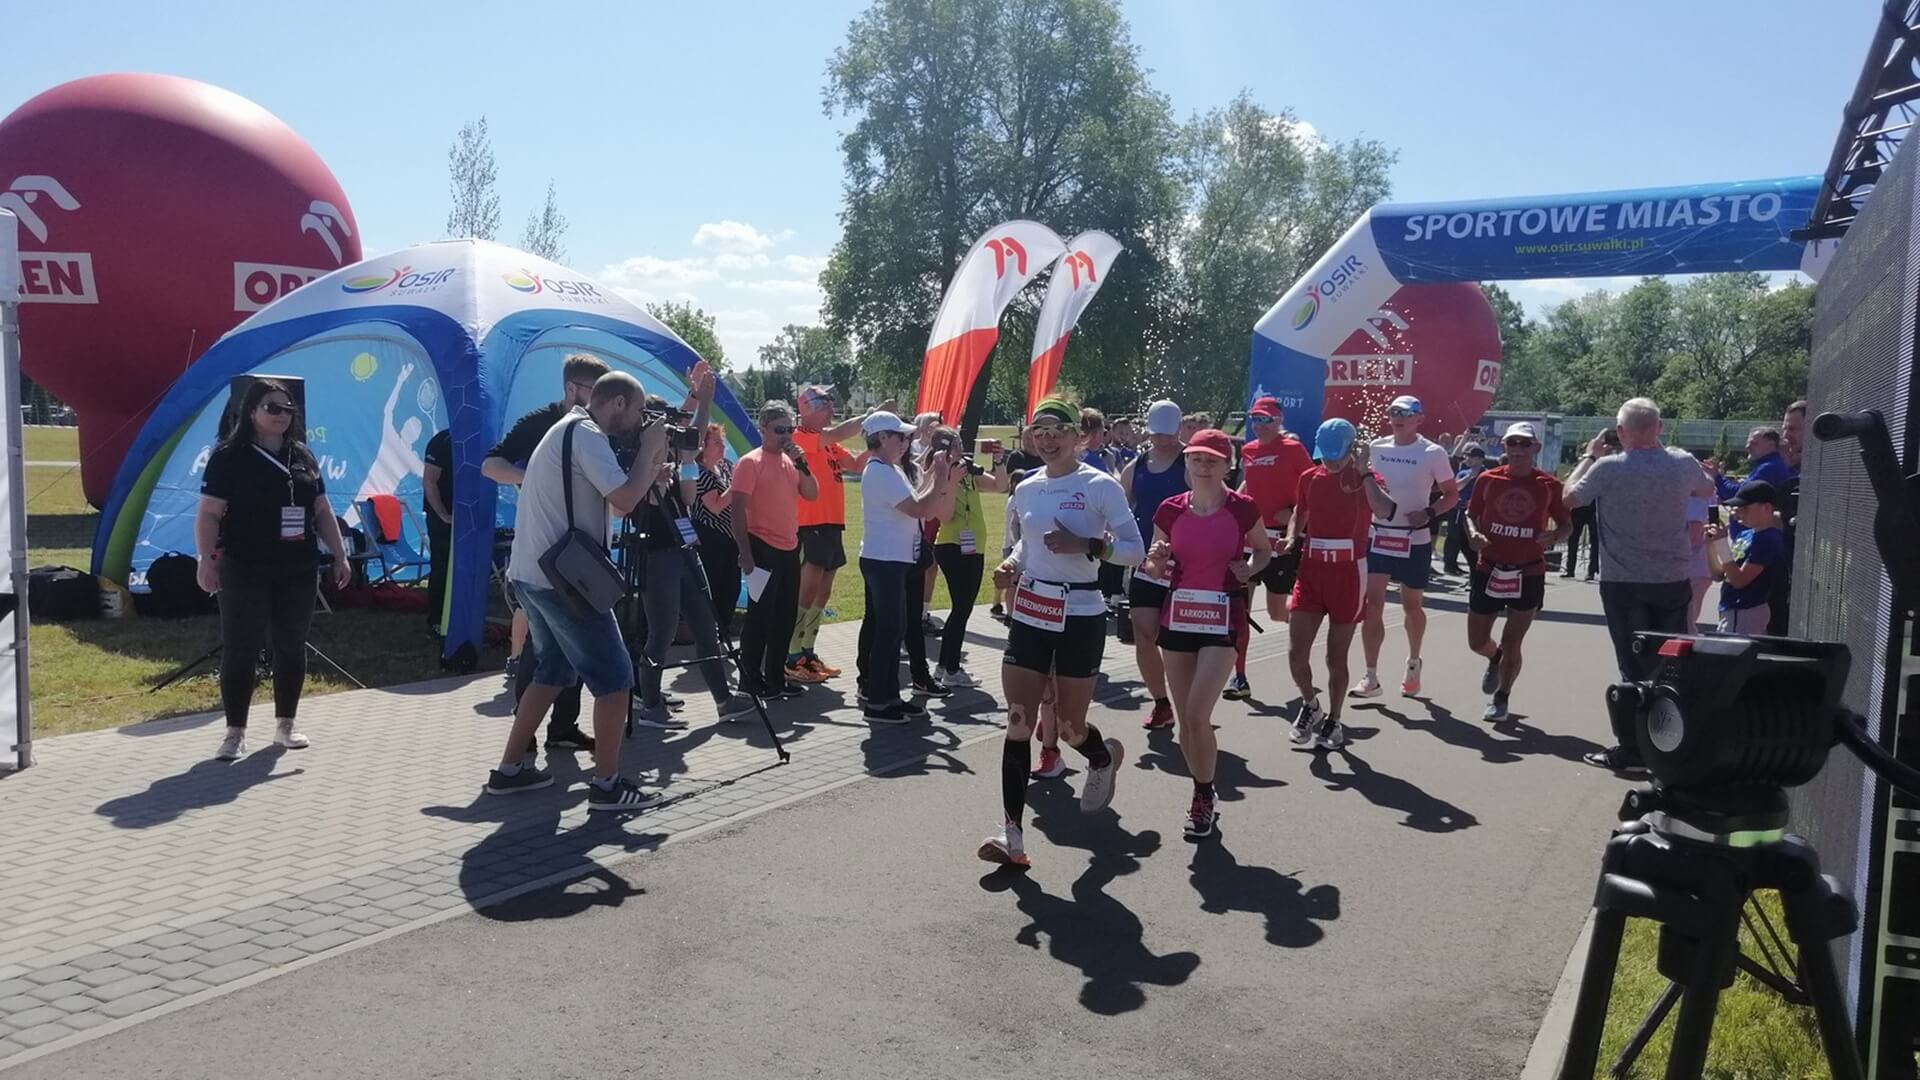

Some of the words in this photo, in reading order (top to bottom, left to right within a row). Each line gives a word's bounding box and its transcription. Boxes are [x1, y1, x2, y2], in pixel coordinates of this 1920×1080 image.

[1403, 203, 1607, 242] SPORTOWE
[1616, 192, 1783, 230] MIASTO
[18, 260, 85, 296] EN
[398, 268, 456, 288] OSIR
[1320, 255, 1363, 296] OSIR
[244, 270, 316, 305] OR
[543, 279, 601, 297] OSIR
[1326, 359, 1405, 381] RLEN
[1275, 396, 1305, 409] PORT
[1321, 550, 1337, 562] 11
[1179, 608, 1221, 619] KARKOSZKA
